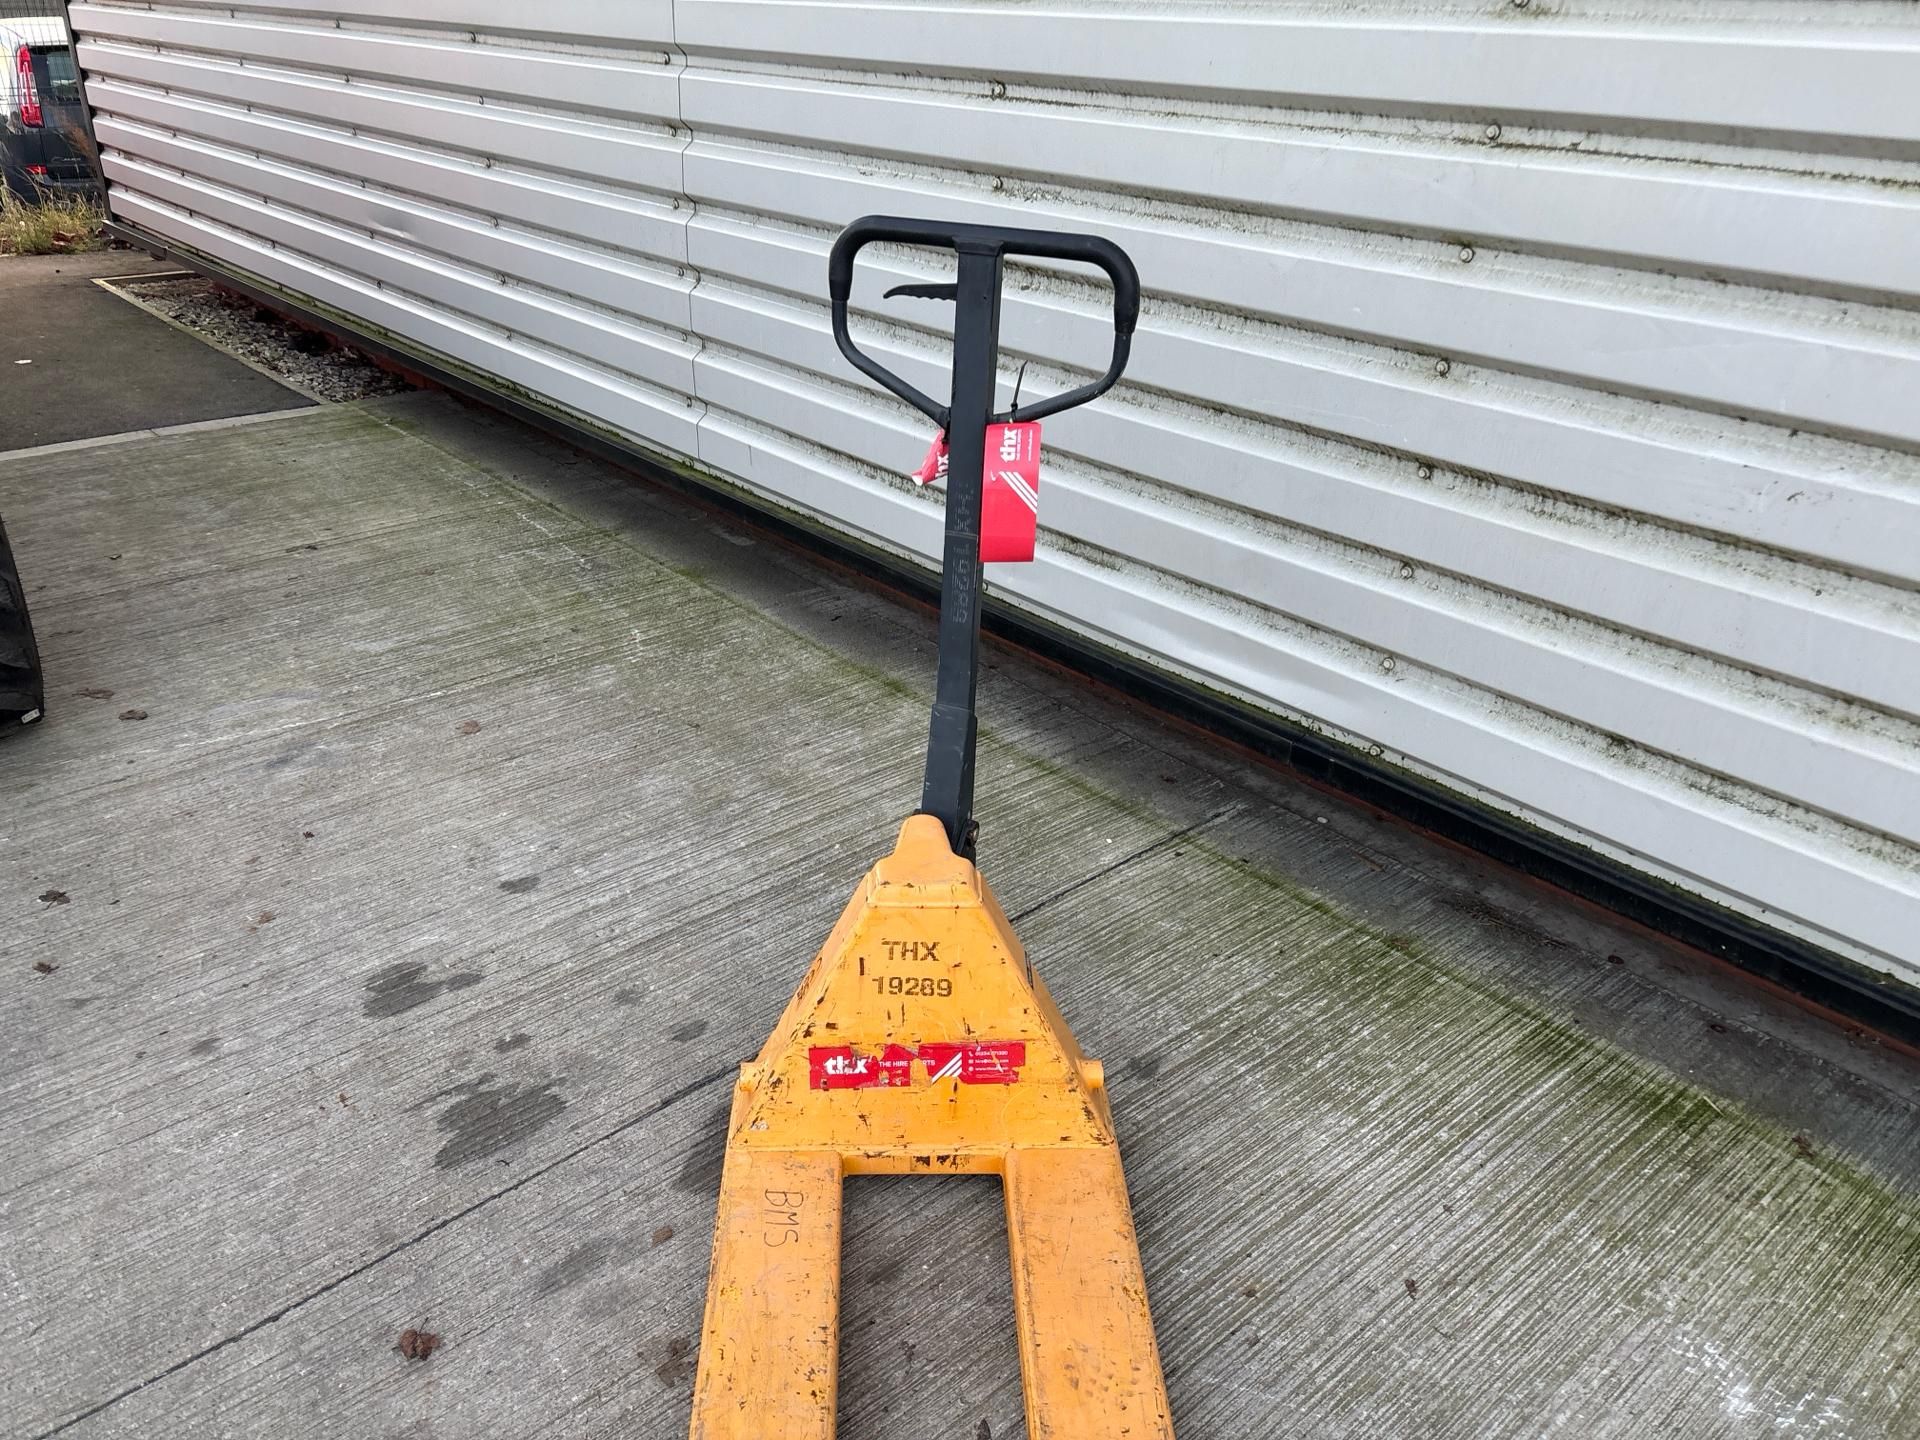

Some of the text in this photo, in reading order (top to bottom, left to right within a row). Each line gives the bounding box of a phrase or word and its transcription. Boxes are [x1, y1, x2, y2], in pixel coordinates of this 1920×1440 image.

[999, 427, 1018, 463] thx
[881, 940, 940, 961] THX
[872, 976, 952, 997] 19289
[764, 1188, 804, 1248] BMS
